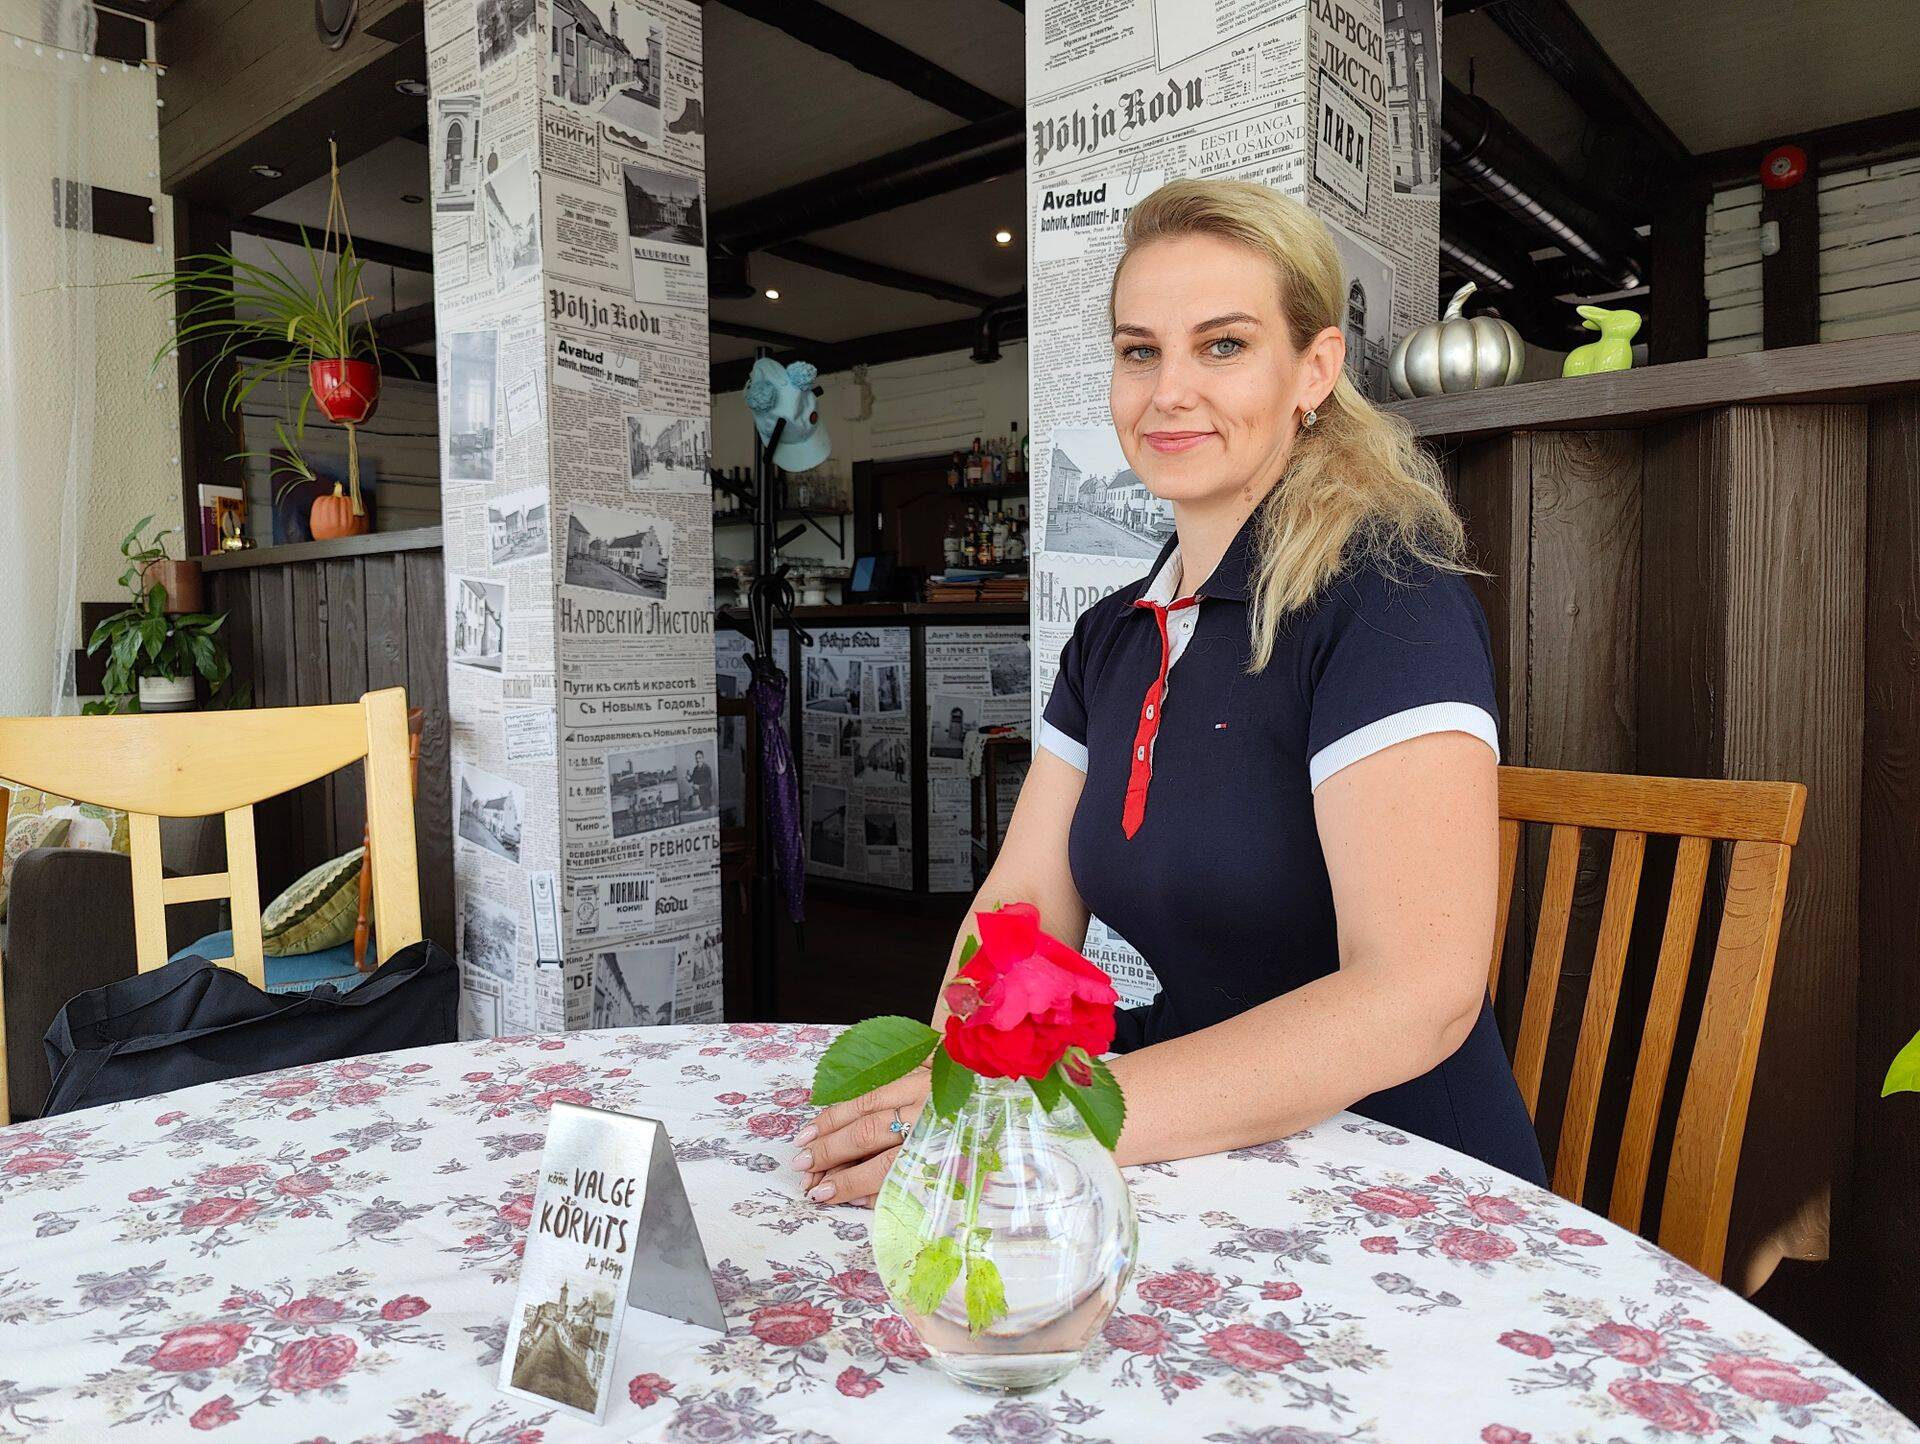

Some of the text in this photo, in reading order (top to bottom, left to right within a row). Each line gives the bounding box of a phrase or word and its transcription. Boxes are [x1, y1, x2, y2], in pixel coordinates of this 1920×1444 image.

[545, 119, 596, 147] КНИГИ
[1032, 103, 1118, 166] Põhja
[1118, 77, 1204, 142] Kodu
[1201, 114, 1293, 152] EESTI PANGA
[1188, 147, 1231, 170] NARVA
[1235, 125, 1306, 156] OSAKOND
[1322, 103, 1364, 174] ПИВА
[1043, 183, 1107, 211] Avatud
[549, 289, 661, 334] Põhja Kodu
[558, 340, 604, 365] Avatud
[564, 680, 594, 696] Пути
[643, 682, 650, 690] и
[579, 696, 706, 715] Съ Новымъ Годомъ!
[650, 834, 720, 859] РЕВНОСТЬ
[573, 1167, 636, 1209] VALGE
[585, 1253, 624, 1280] ja glögg
